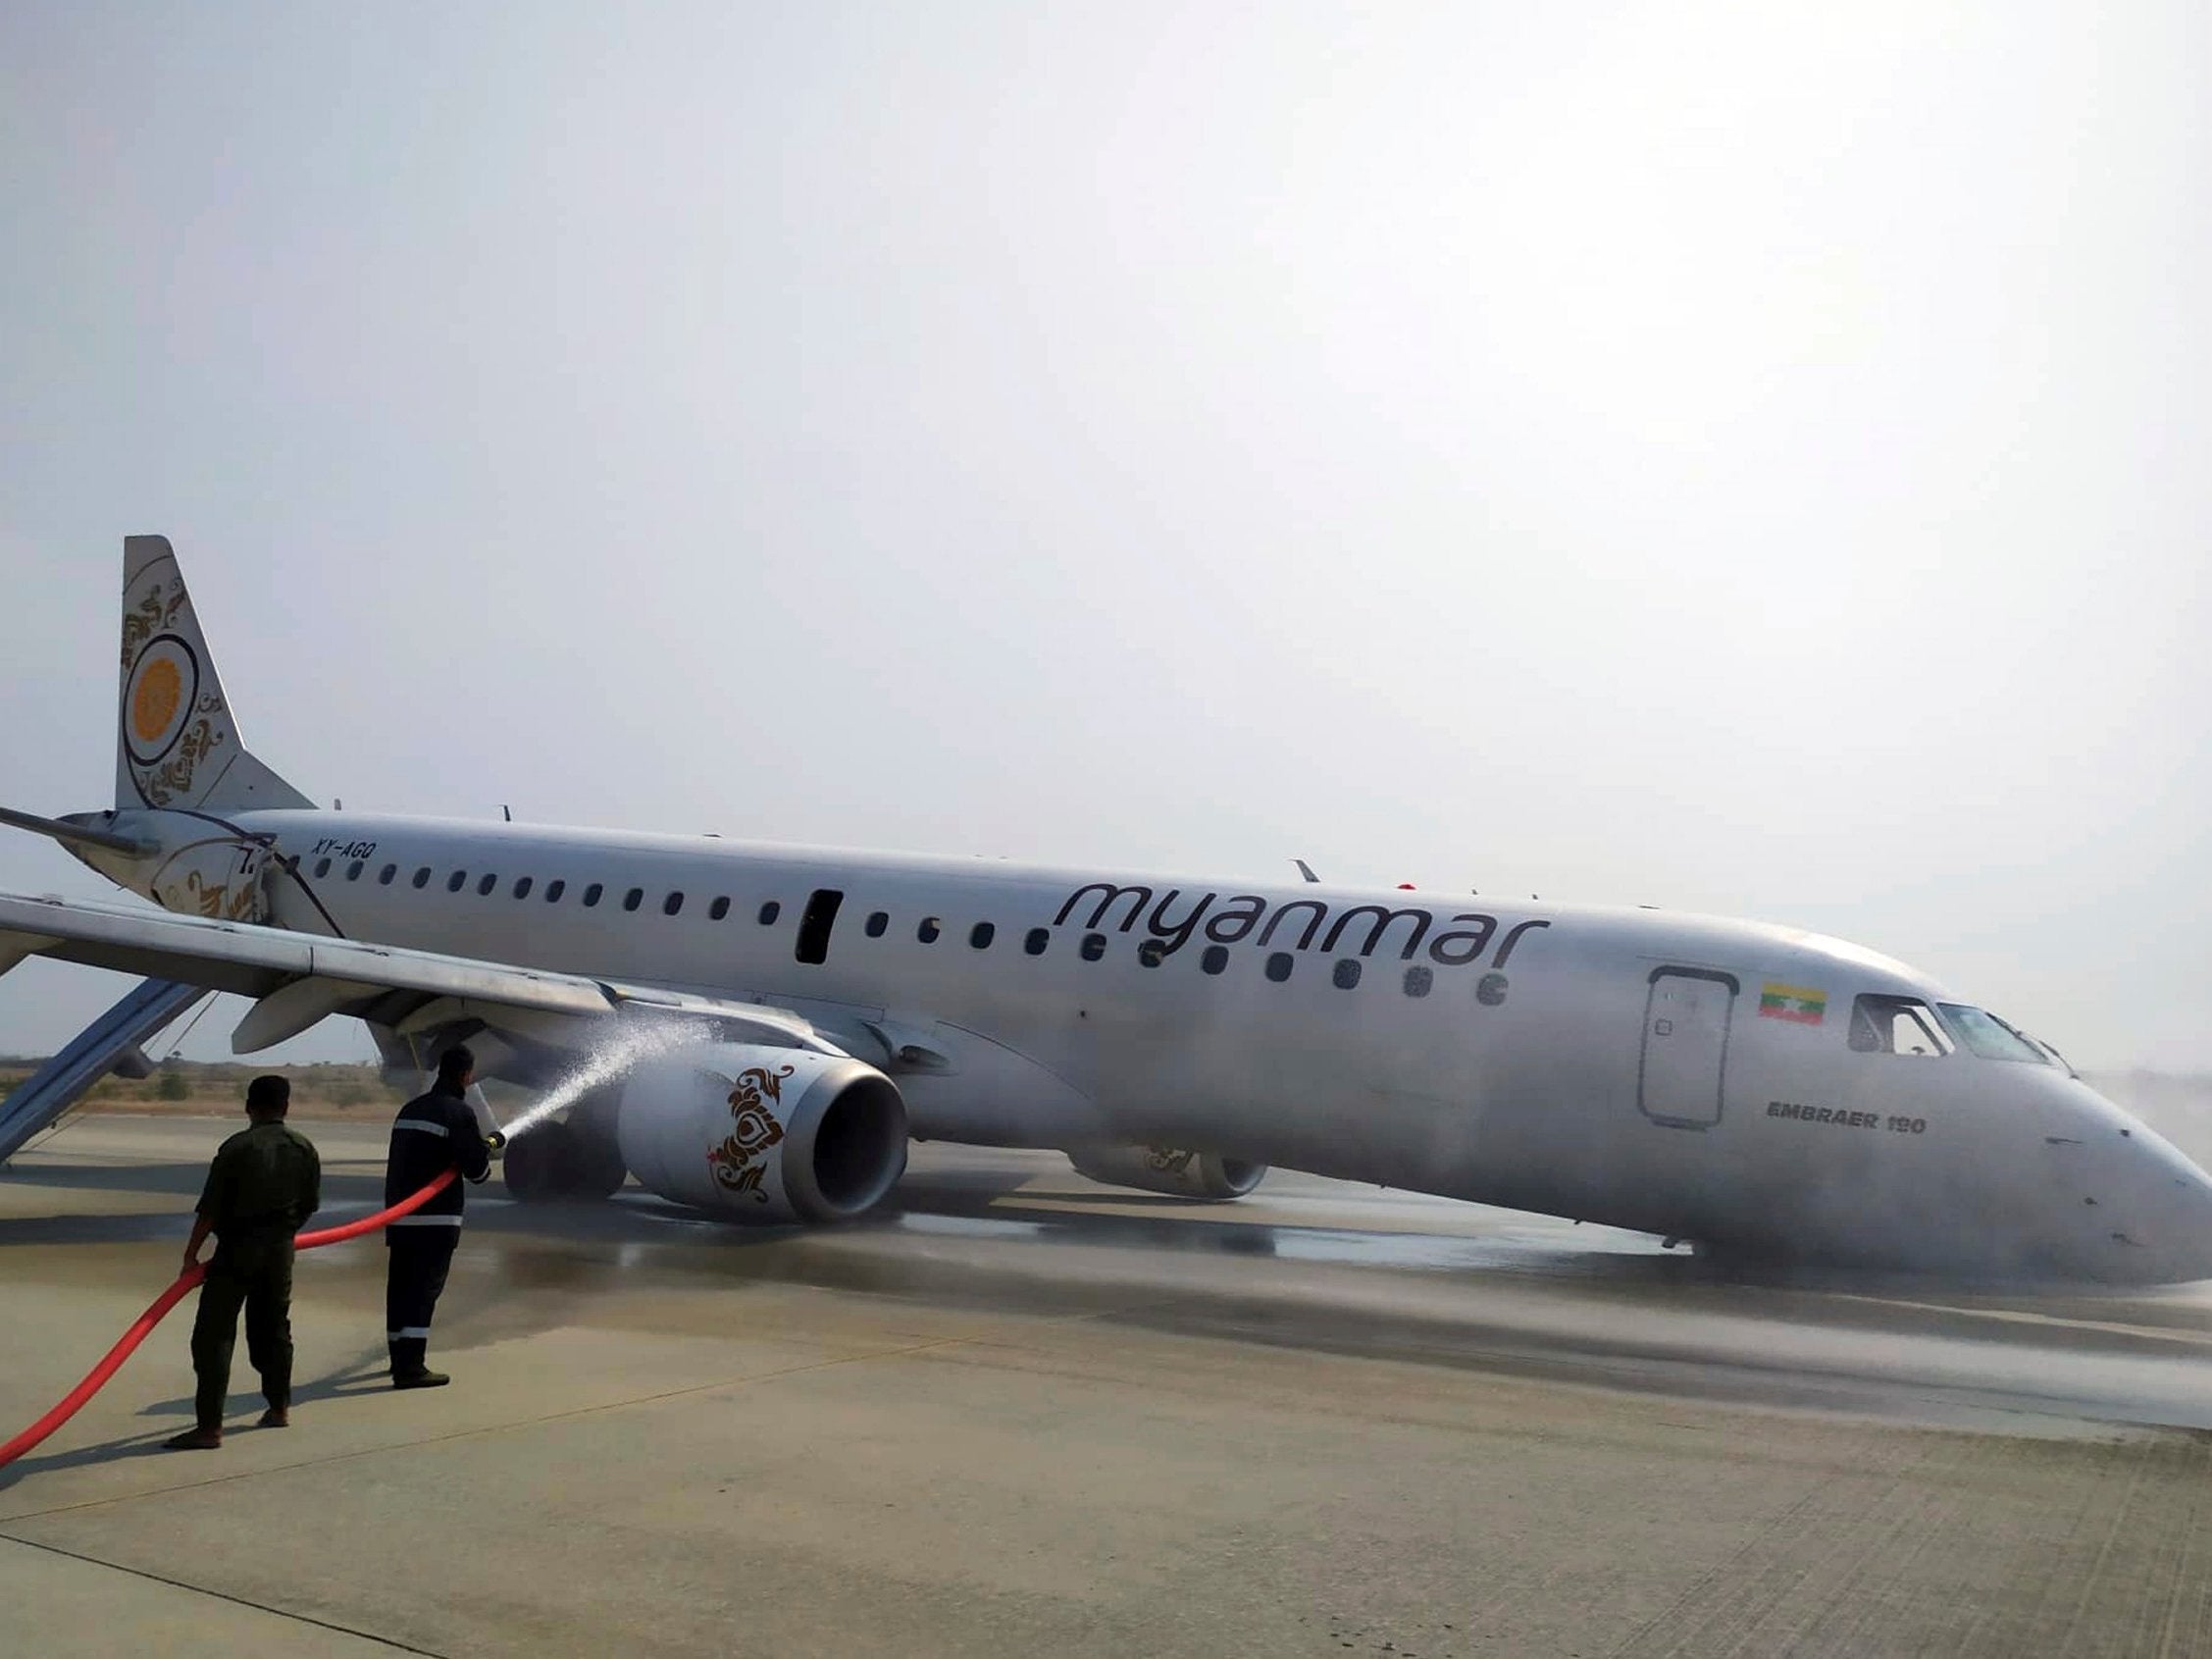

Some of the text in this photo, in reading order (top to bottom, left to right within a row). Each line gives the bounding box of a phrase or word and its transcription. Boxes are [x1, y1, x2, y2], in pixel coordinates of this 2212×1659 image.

[1053, 883, 1551, 968] myanmar
[1767, 1101, 1927, 1134] EMBRAER 190
